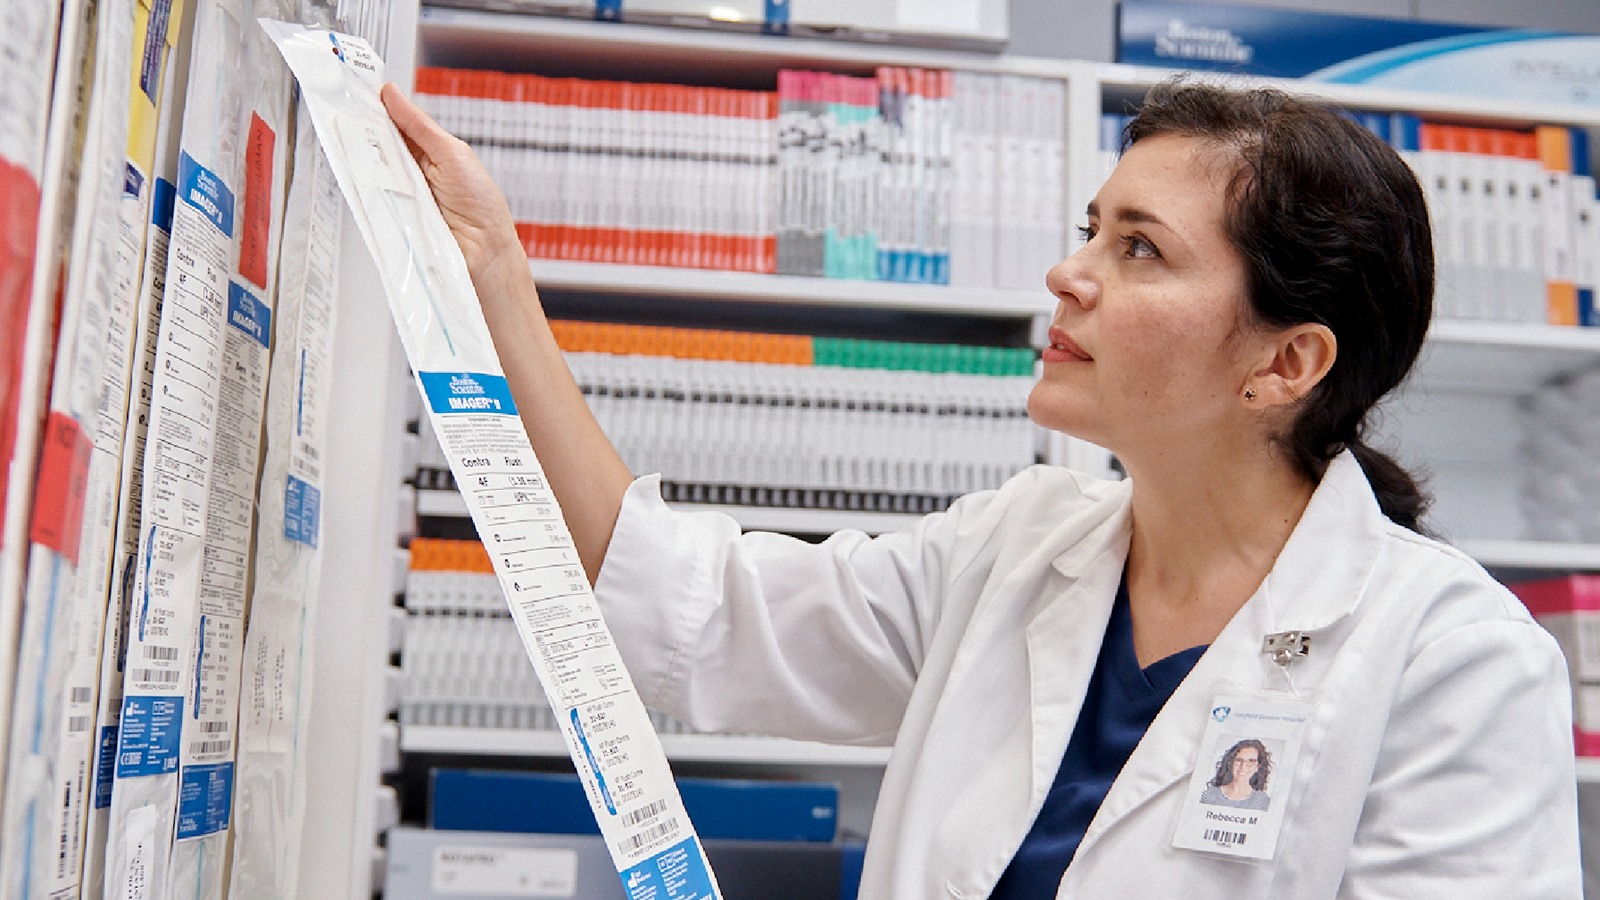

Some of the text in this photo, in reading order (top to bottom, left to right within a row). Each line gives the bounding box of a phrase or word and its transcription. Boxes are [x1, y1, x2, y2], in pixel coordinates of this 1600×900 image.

[254, 128, 264, 190] HUMAN
[449, 376, 479, 386] Boston
[449, 384, 486, 394] Scientific
[462, 456, 524, 468] Contra Flush
[478, 476, 488, 487] 4F
[1206, 811, 1258, 824] Rebecca M
